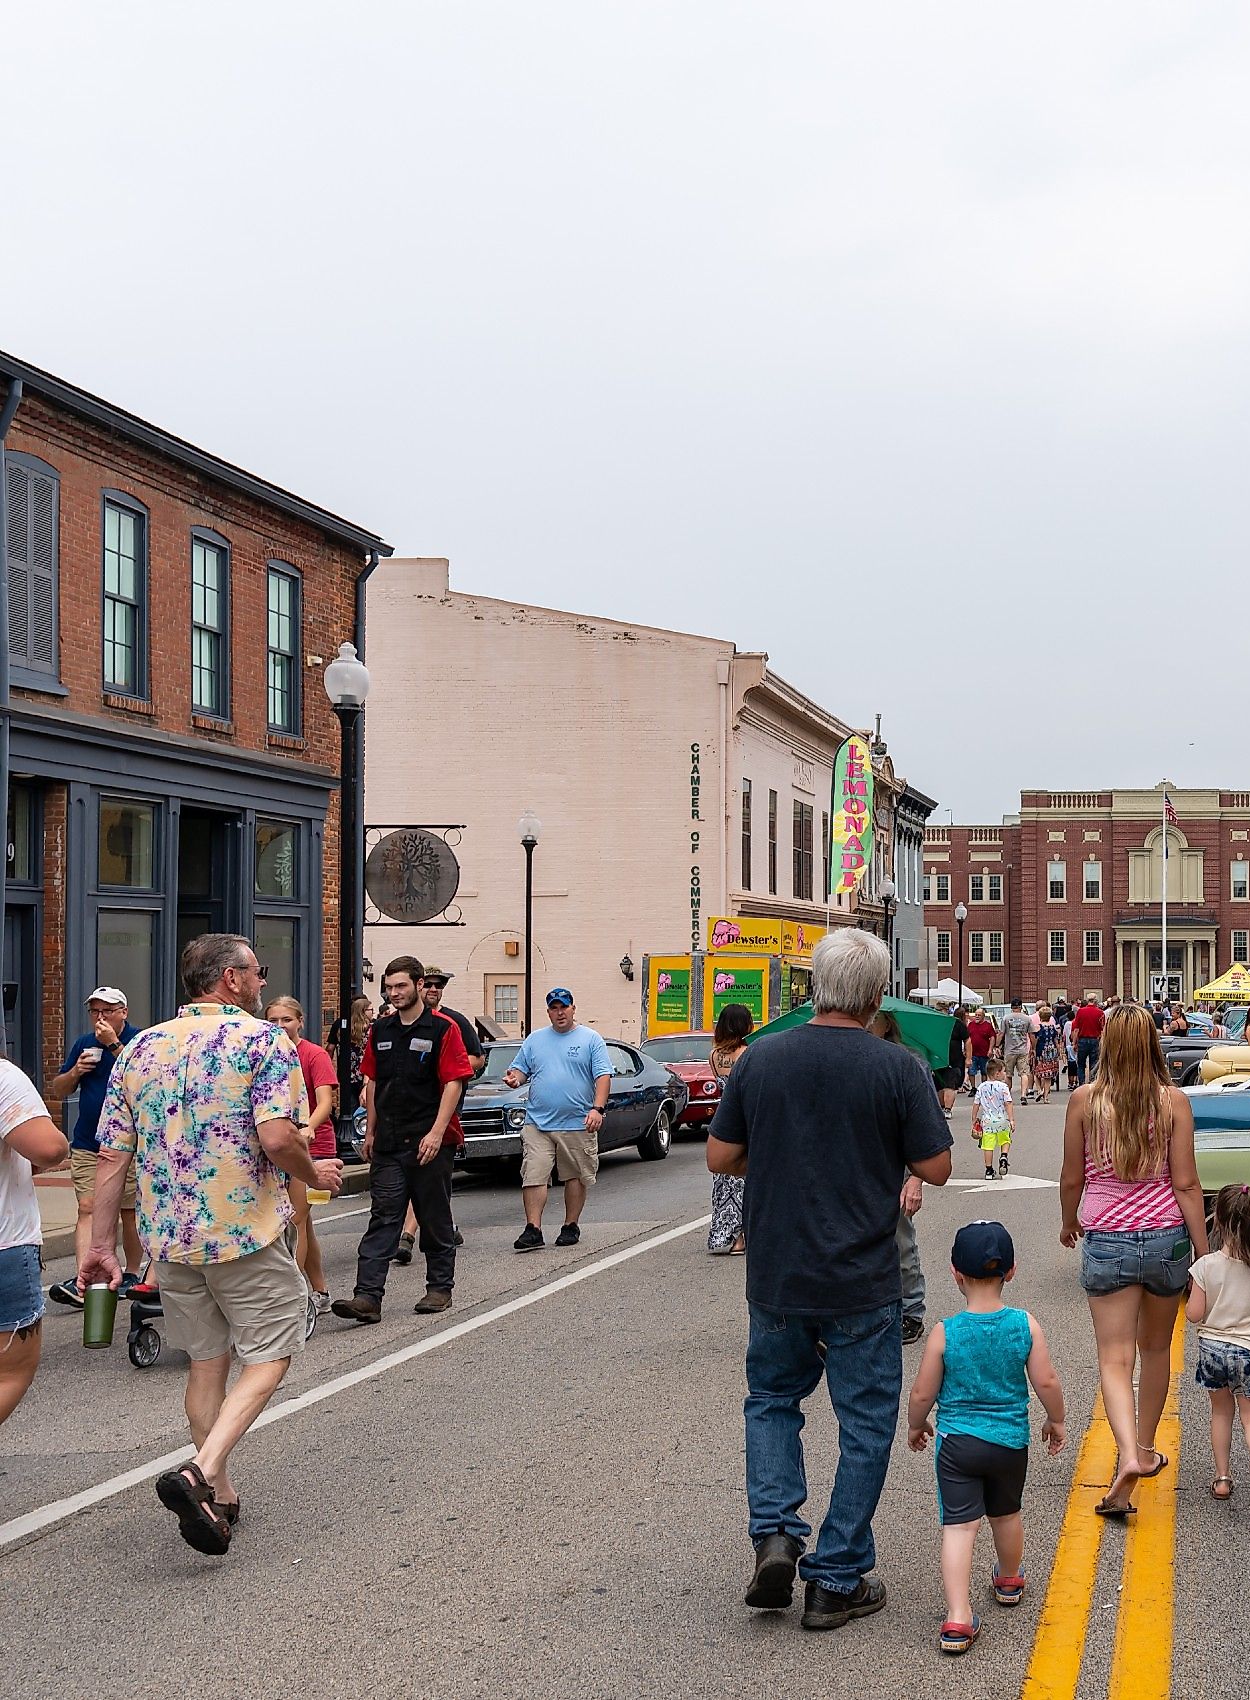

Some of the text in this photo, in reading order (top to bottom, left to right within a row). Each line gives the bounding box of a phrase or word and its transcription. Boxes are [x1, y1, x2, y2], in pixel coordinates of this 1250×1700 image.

[841, 744, 868, 888] LEMONADE
[690, 742, 701, 951] CHAMBER OF COMMERCE
[727, 933, 779, 945] Dewster's
[664, 983, 690, 991] Dewster's
[724, 982, 763, 990] Dewster's
